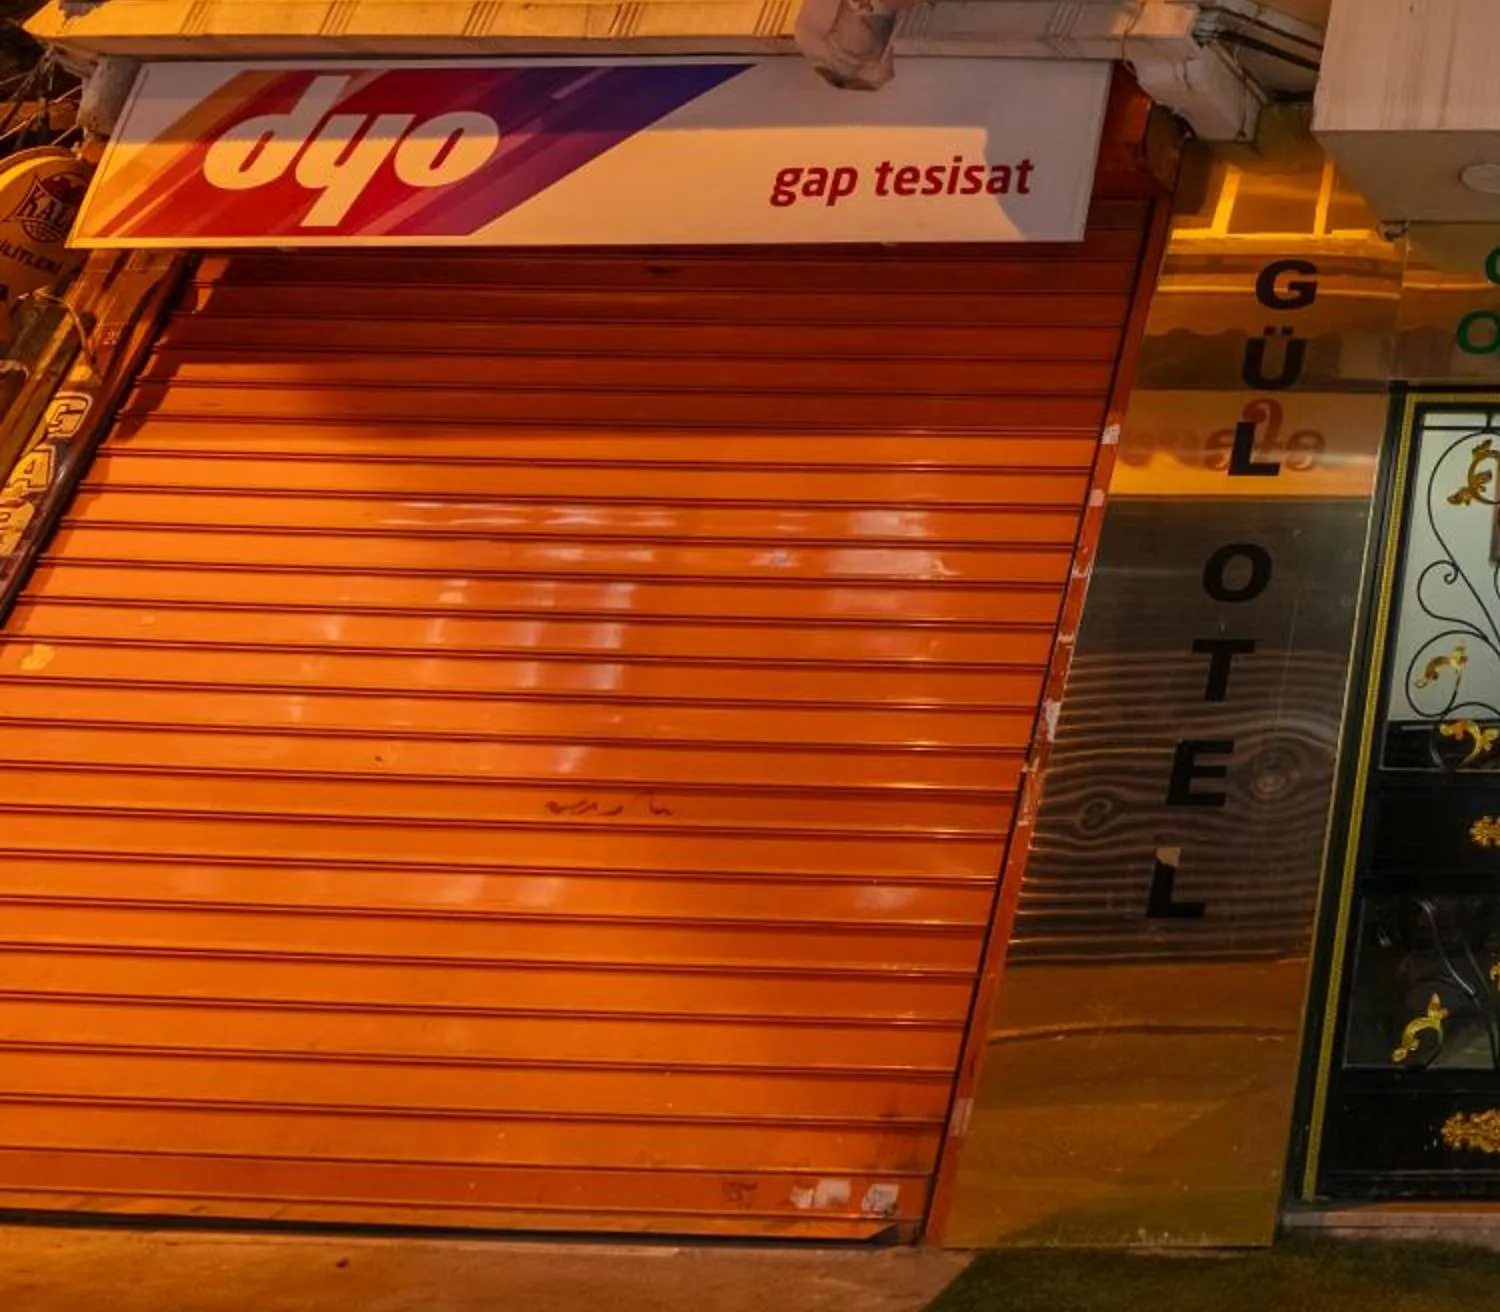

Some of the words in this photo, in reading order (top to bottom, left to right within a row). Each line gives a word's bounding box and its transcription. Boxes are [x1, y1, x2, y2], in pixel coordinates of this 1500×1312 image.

[202, 75, 500, 228] dyo
[770, 166, 858, 207] gap
[874, 155, 1034, 196] tesisat
[1227, 259, 1318, 476] GÜL
[1145, 542, 1273, 919] OTEL
